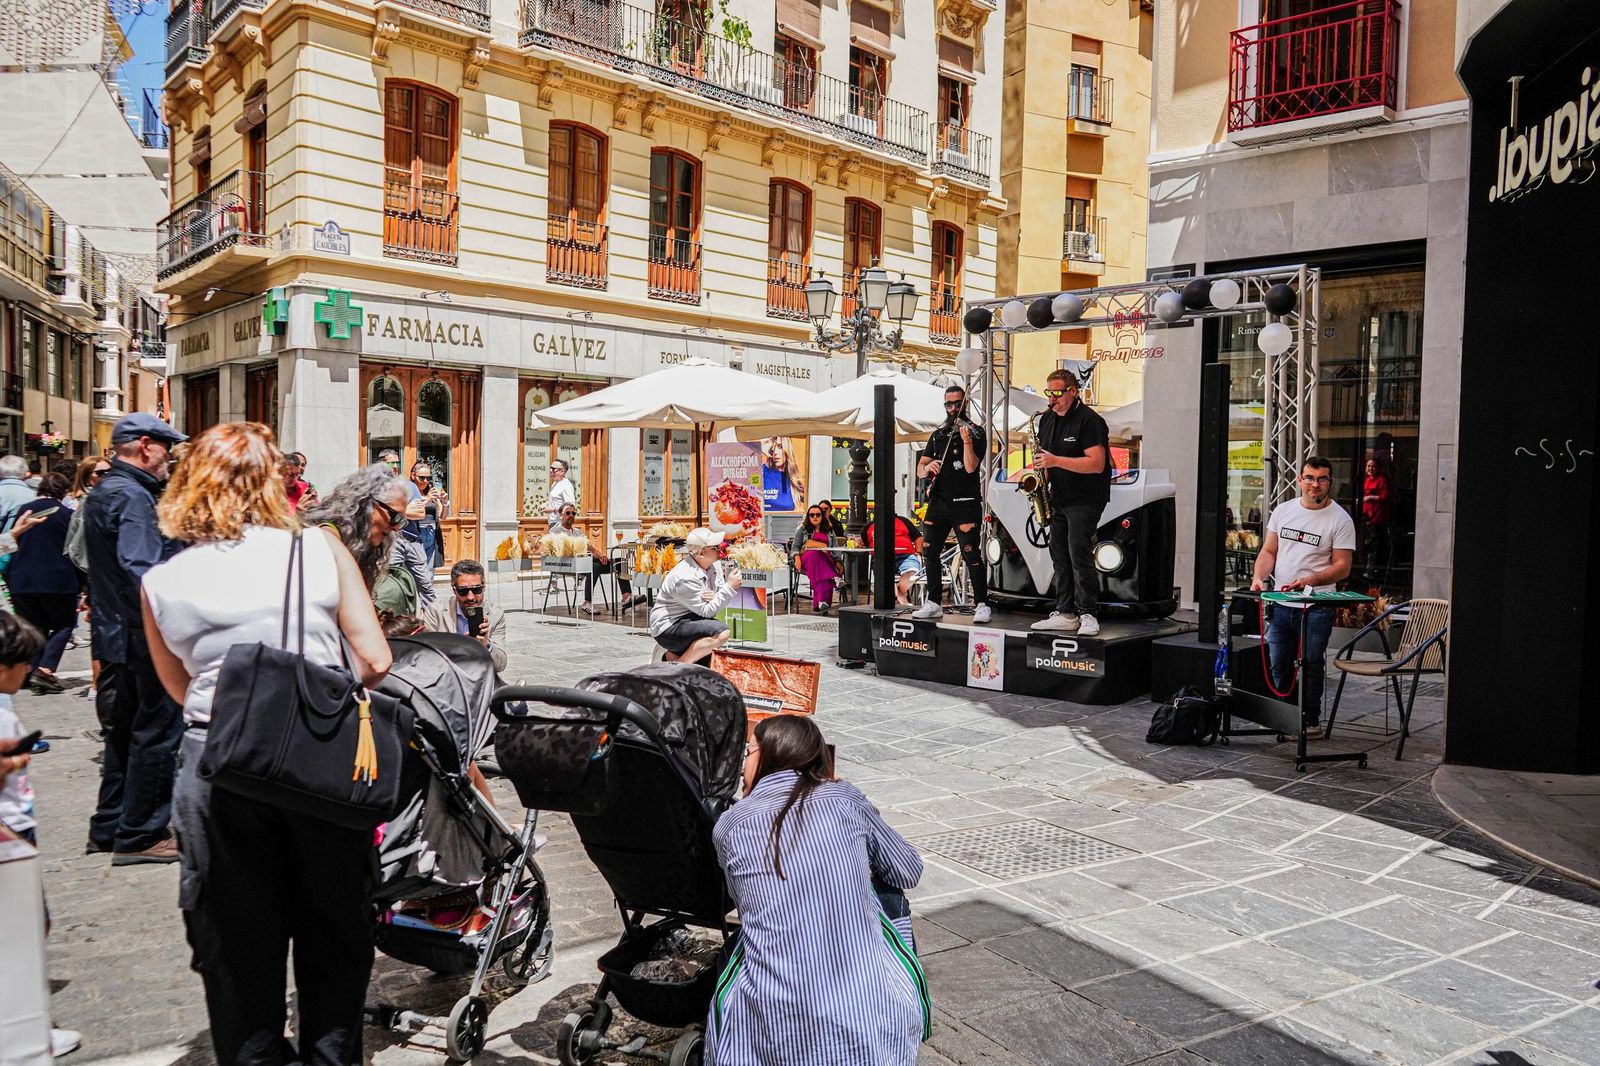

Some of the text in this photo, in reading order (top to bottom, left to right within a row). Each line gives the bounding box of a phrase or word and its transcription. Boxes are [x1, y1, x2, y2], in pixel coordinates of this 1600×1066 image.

[180, 331, 210, 357] FARMACIA
[367, 313, 484, 348] FARMACIA
[533, 332, 607, 361] GALVEZ
[756, 362, 811, 380] MAGISTRALES
[711, 453, 759, 468] ALCACHOFÍSIMA
[723, 467, 748, 479] BURGER
[879, 637, 928, 651] polomusic
[1035, 656, 1096, 672] polomusic
